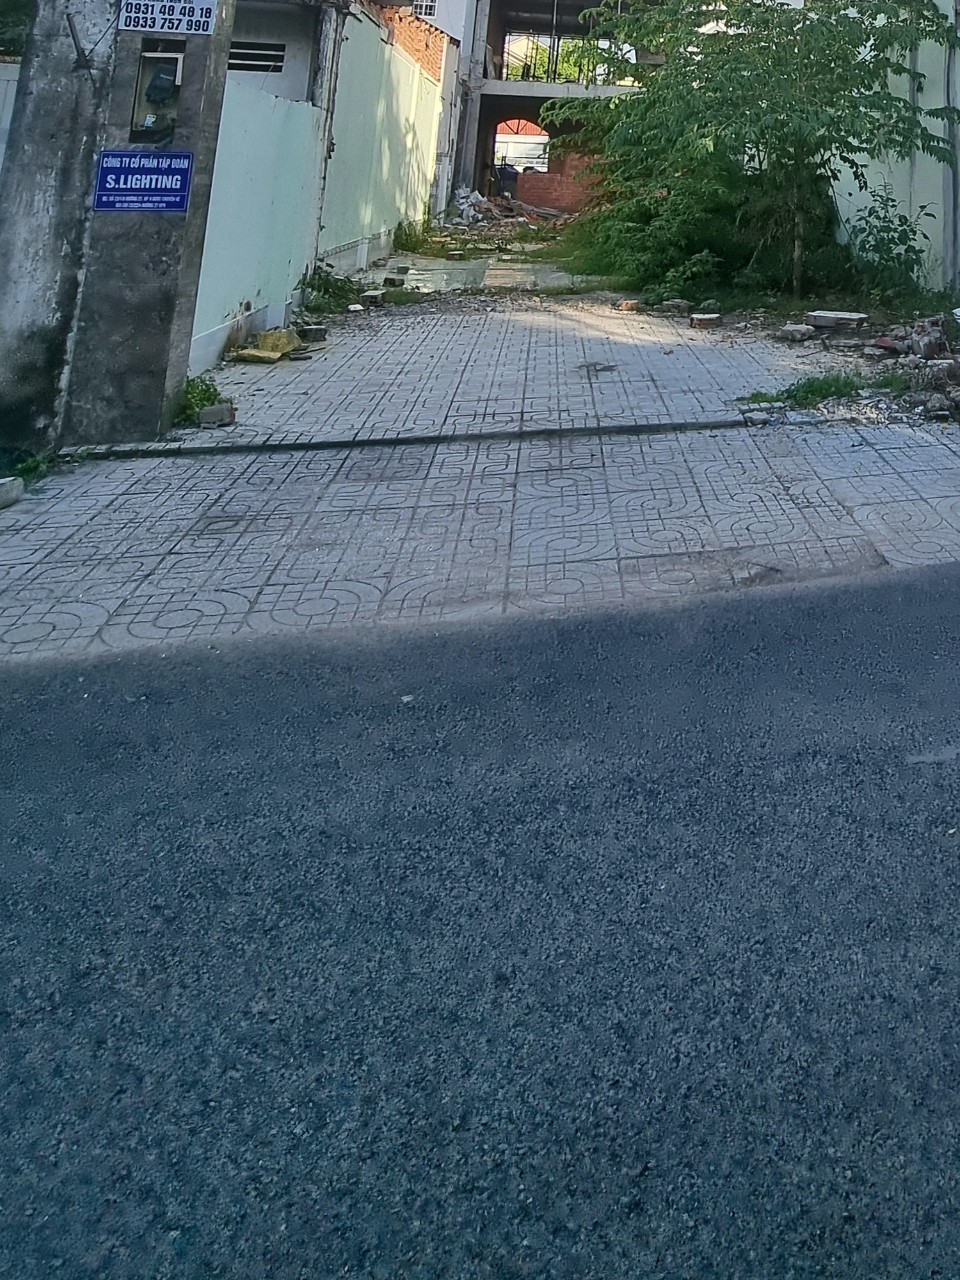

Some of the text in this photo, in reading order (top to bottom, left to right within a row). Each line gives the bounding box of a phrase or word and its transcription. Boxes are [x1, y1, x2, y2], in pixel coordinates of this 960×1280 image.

[125, 2, 212, 19] 0931 48 48 18
[124, 15, 209, 32] 0933 757 990
[103, 155, 121, 168] CÔNG
[121, 157, 130, 168] TY
[158, 156, 171, 170] TẬP
[171, 156, 189, 169] ĐOÀN
[105, 174, 182, 189] S.LIGHTING
